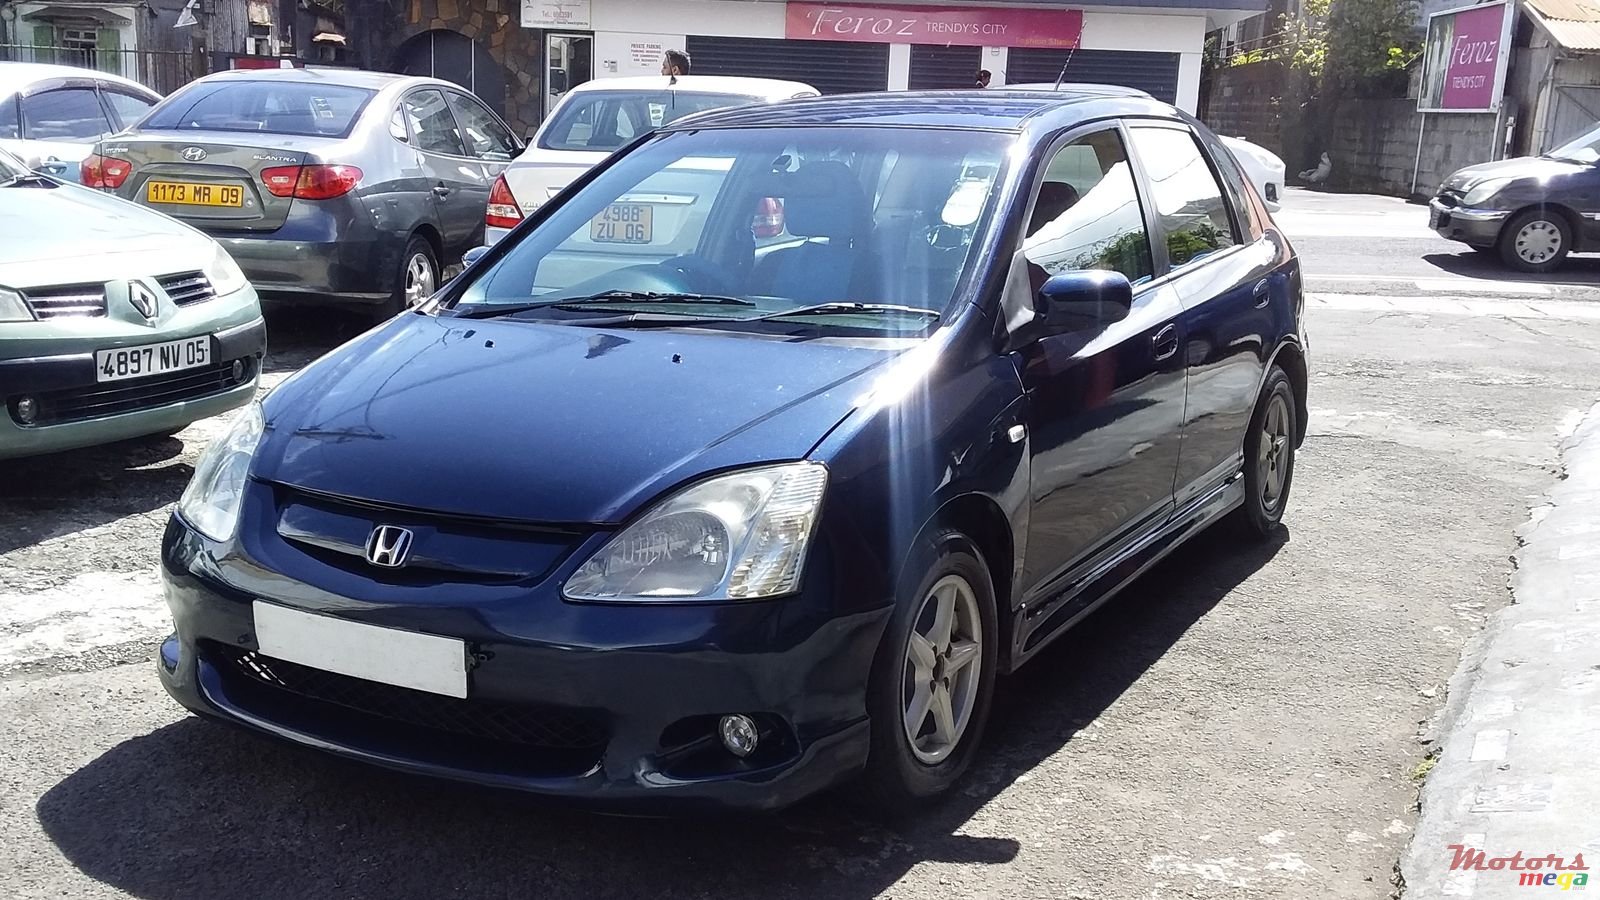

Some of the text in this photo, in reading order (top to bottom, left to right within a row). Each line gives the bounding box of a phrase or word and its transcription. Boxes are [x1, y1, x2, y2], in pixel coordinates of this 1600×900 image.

[807, 9, 1008, 35] Feroz TRENDY'S CITY
[1450, 35, 1498, 69] Feroz
[153, 184, 239, 204] 1173 MR 09
[603, 206, 640, 222] 4988
[597, 223, 644, 240] ZU 06
[103, 340, 205, 377] 4897 NV 05
